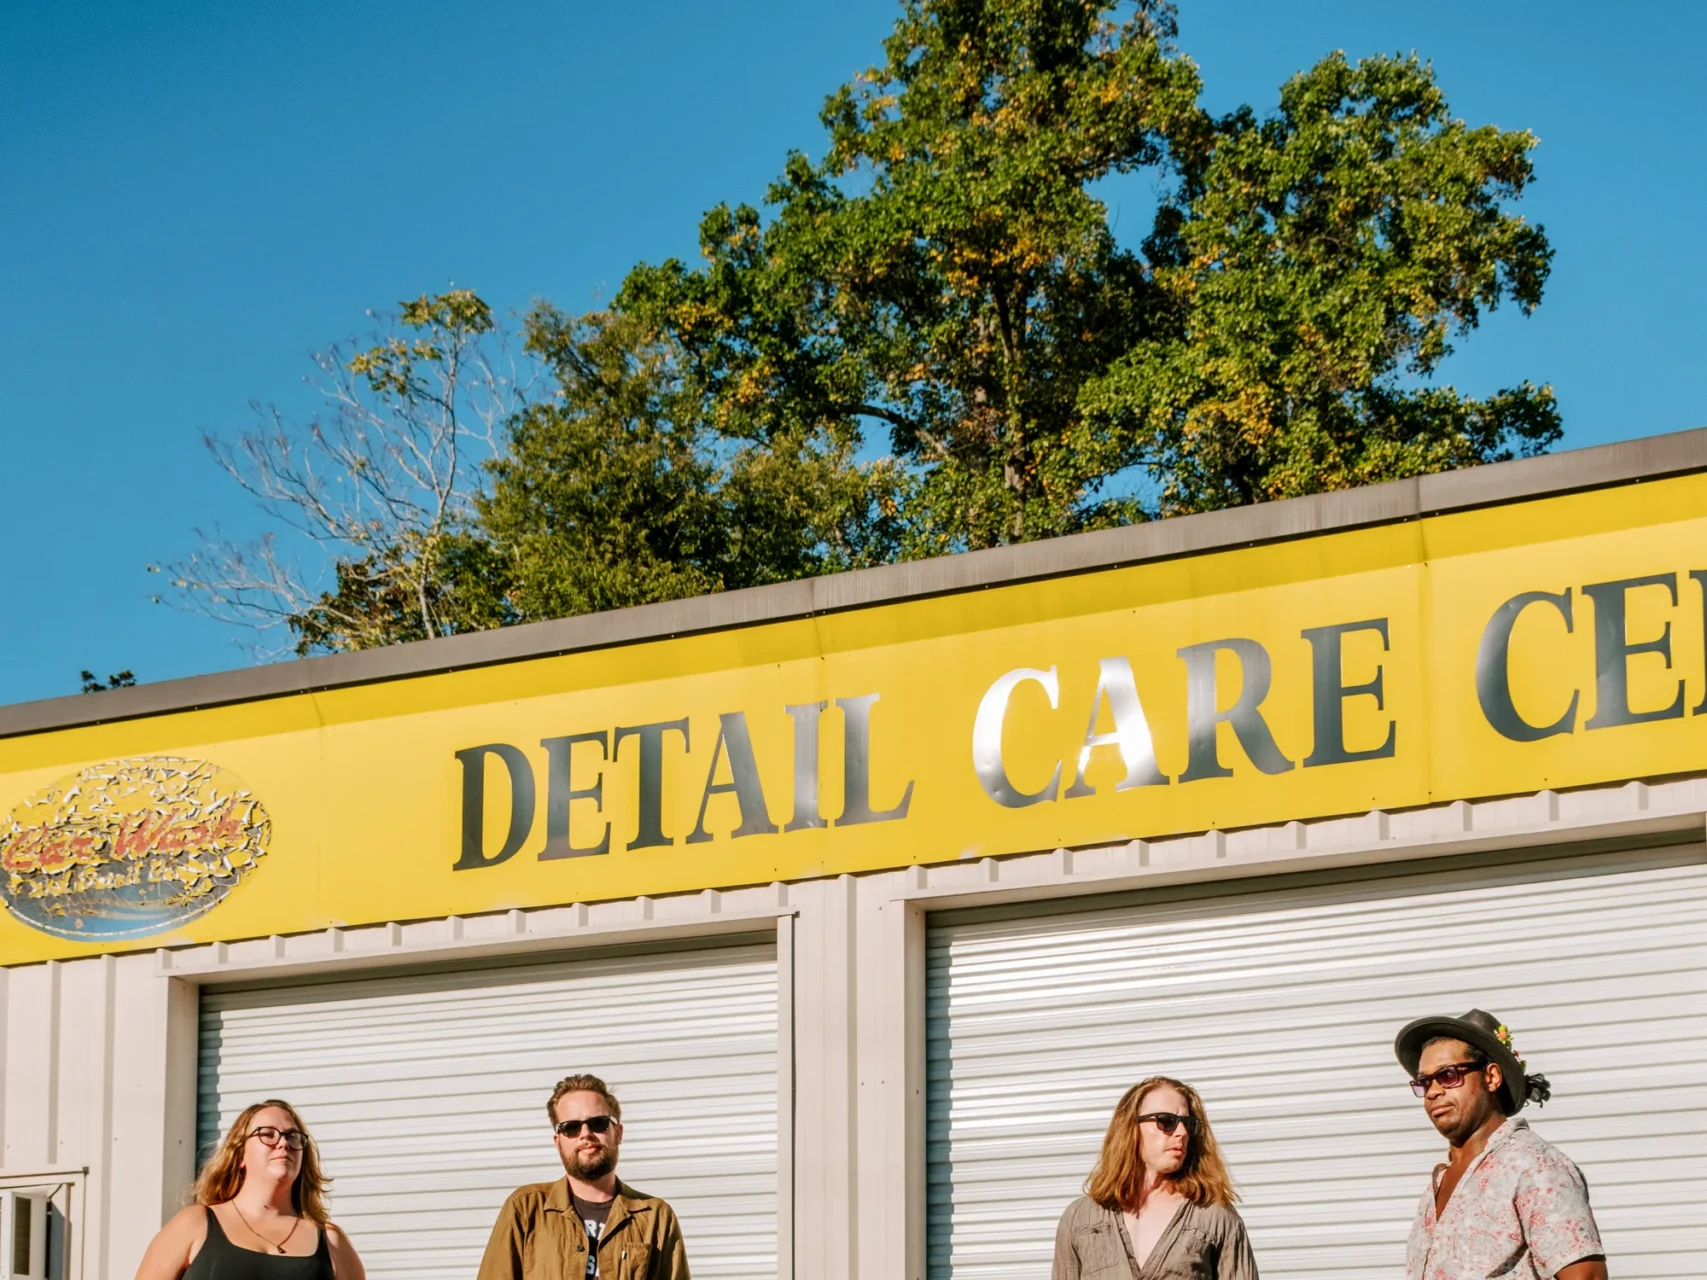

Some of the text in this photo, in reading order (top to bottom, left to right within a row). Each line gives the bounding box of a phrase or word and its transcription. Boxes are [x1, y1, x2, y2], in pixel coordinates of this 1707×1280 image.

[453, 569, 1707, 872] DETAIL CARE CE
